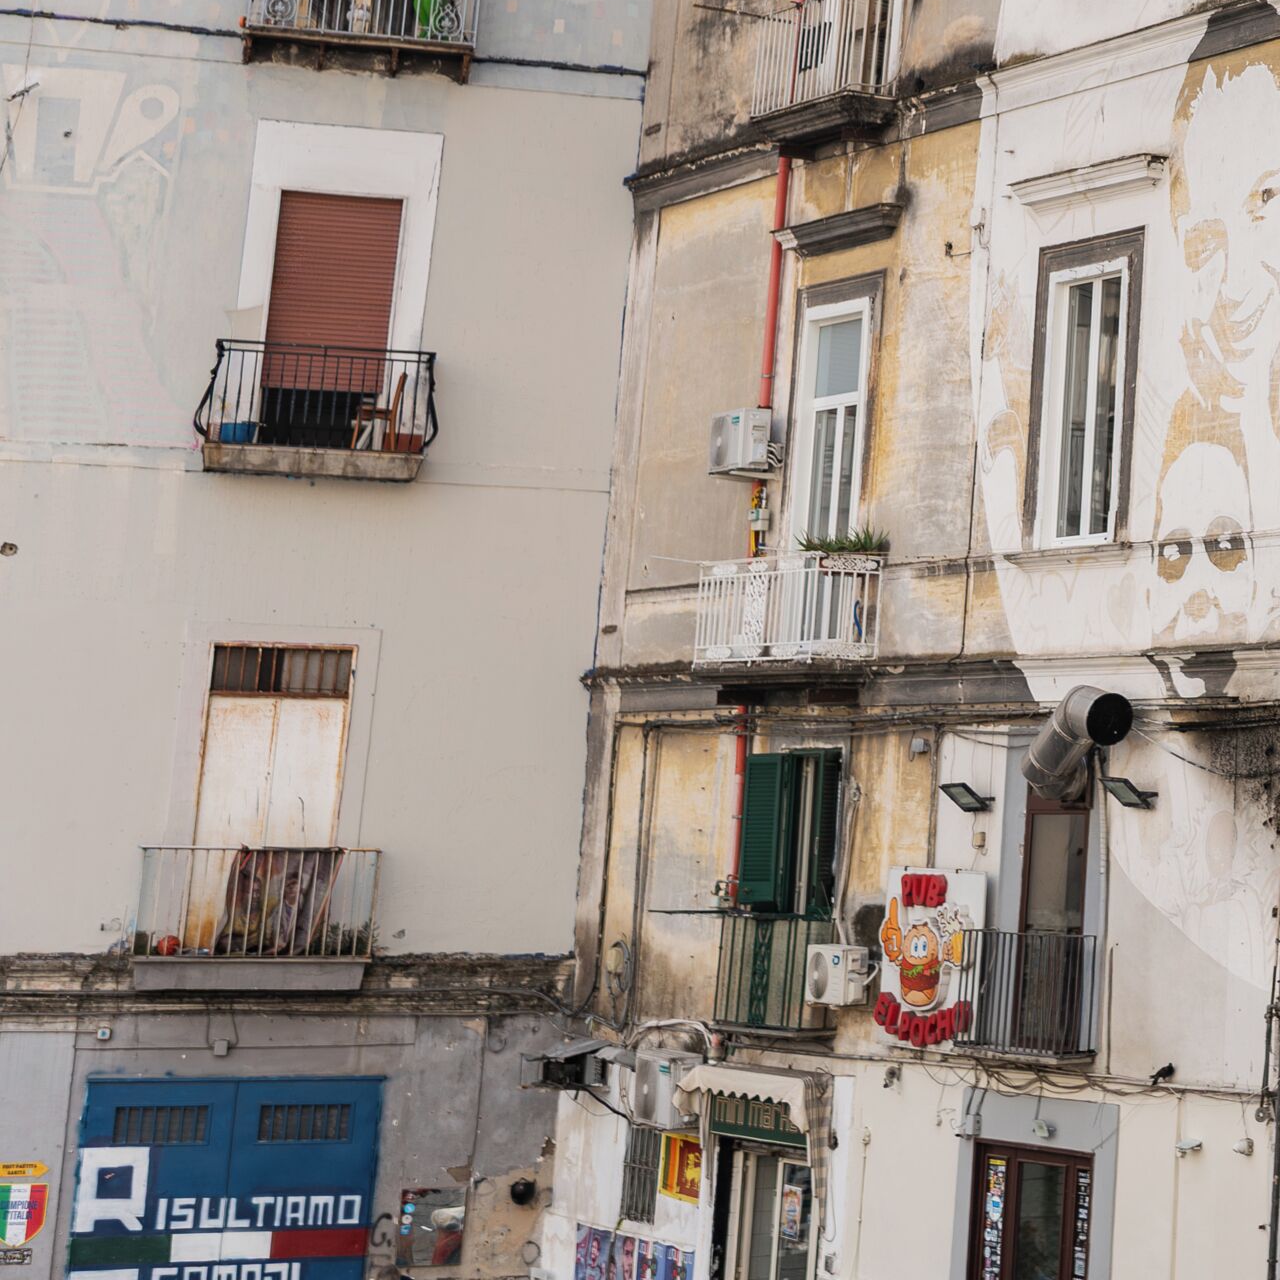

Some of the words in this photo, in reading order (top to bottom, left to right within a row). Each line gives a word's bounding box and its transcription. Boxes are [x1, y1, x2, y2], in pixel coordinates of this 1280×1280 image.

[901, 874, 947, 907] PUB
[715, 1096, 745, 1125] mini
[72, 1146, 362, 1233] RISULTIAMO
